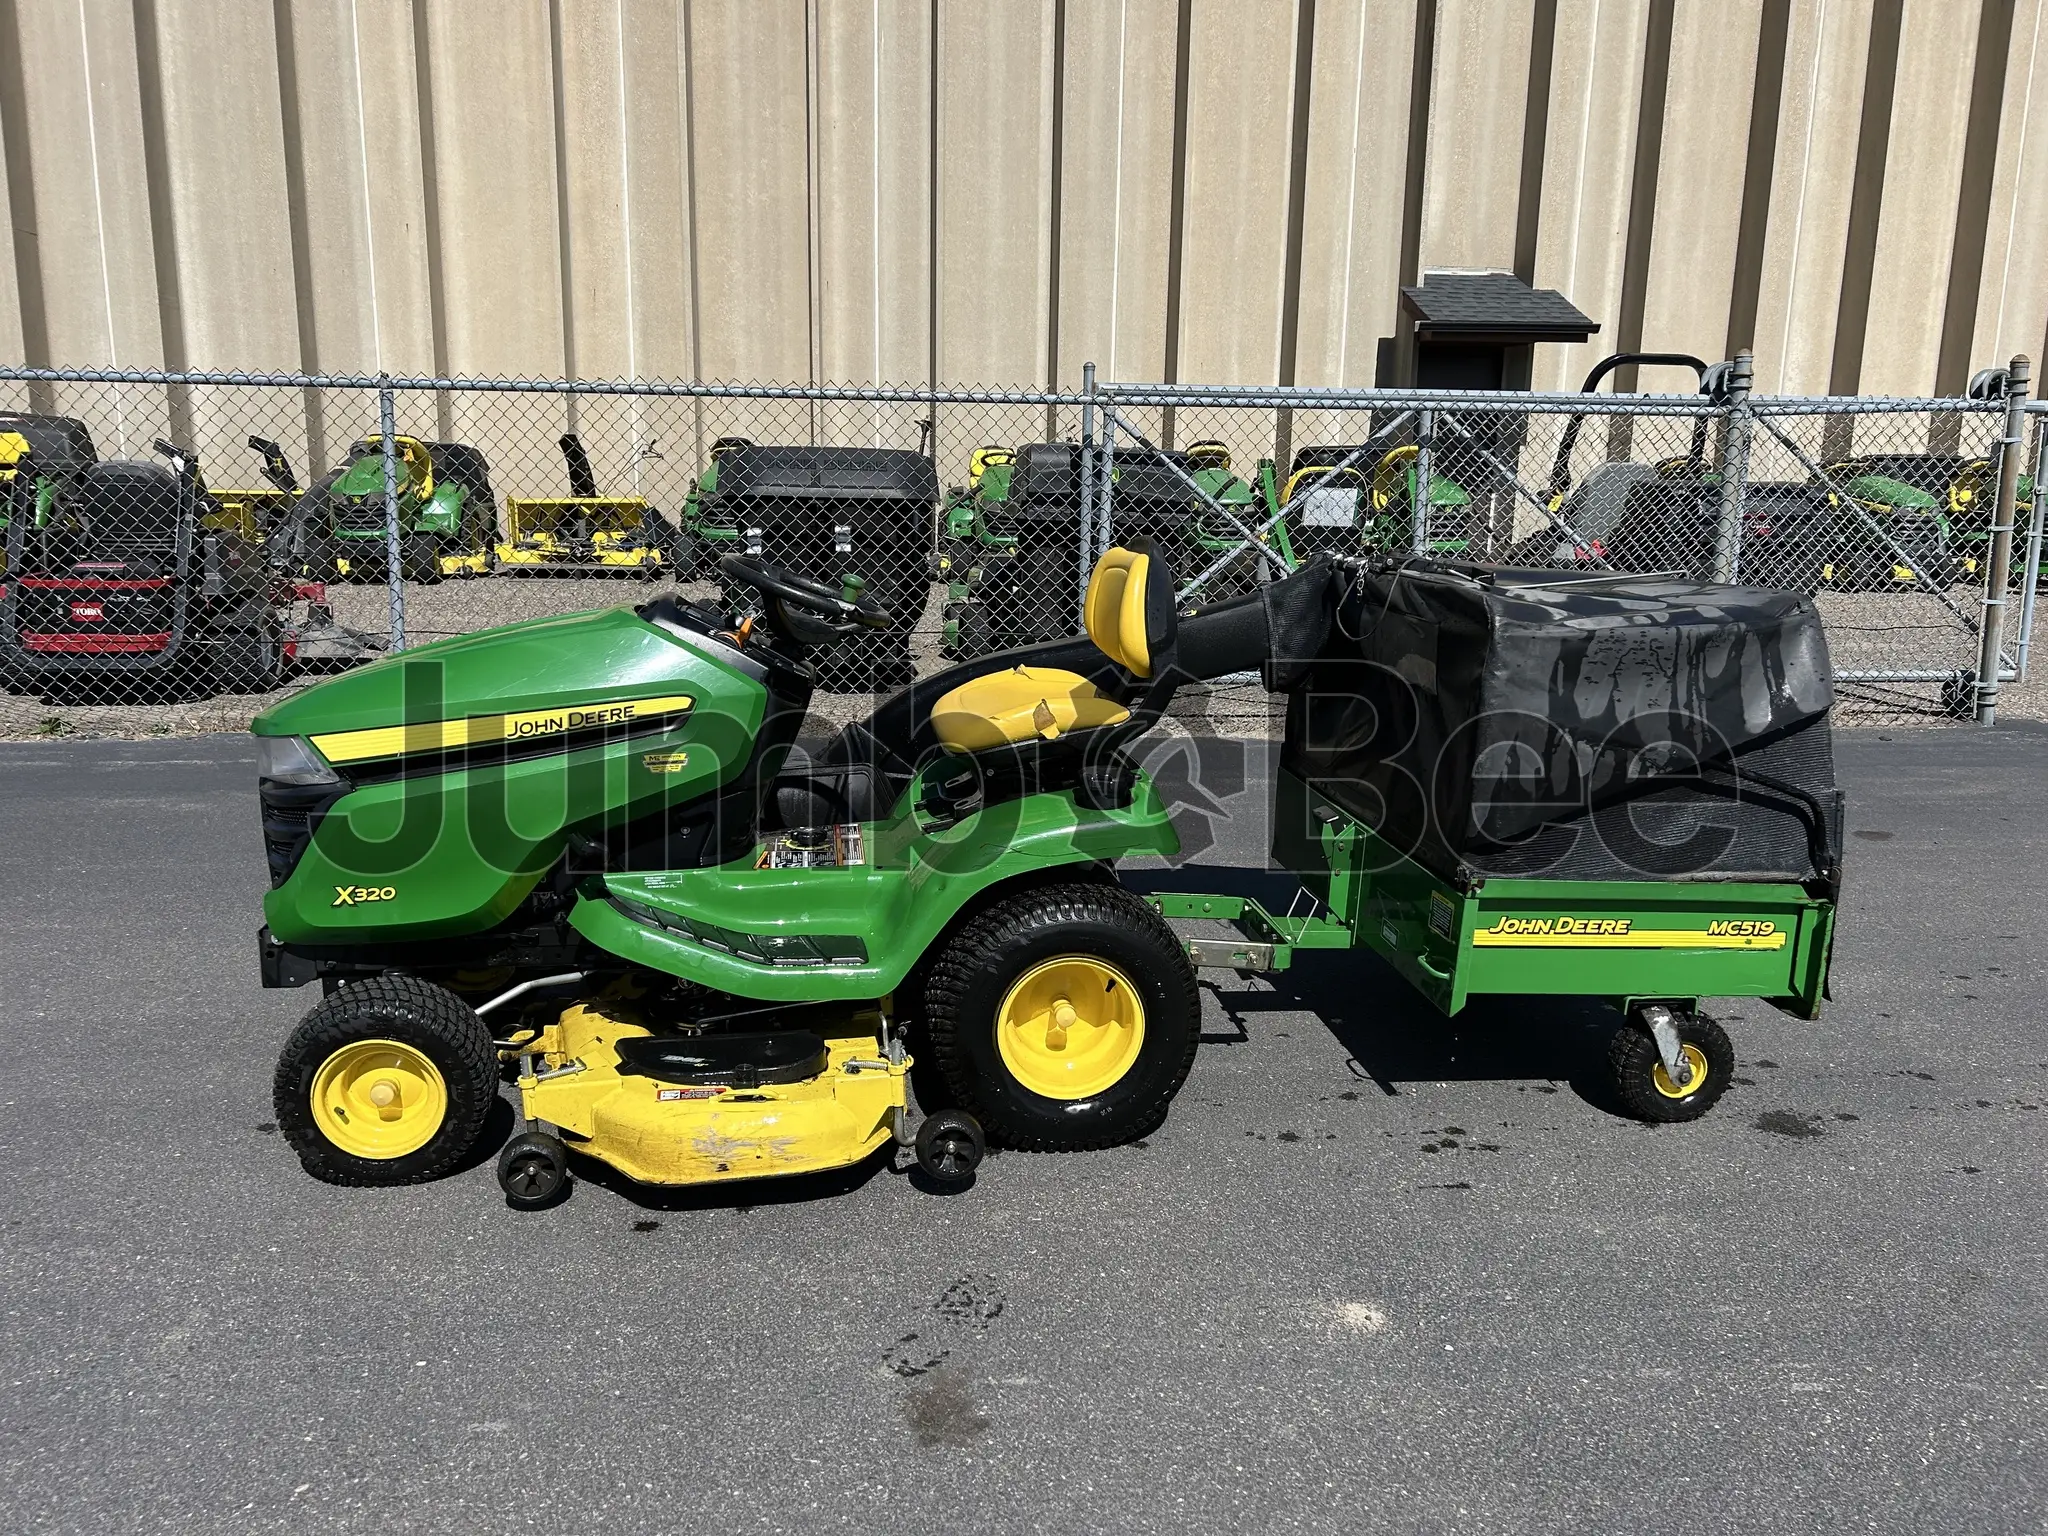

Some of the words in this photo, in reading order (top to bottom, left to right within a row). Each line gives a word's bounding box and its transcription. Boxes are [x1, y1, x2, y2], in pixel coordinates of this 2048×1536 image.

[75, 607, 102, 616] TORO
[507, 717, 563, 738] JOHN
[568, 705, 635, 728] DEERE
[332, 885, 397, 906] X320
[1489, 916, 1553, 935] JOHN
[1554, 917, 1632, 935] DEERE
[1708, 920, 1776, 936] MC519
